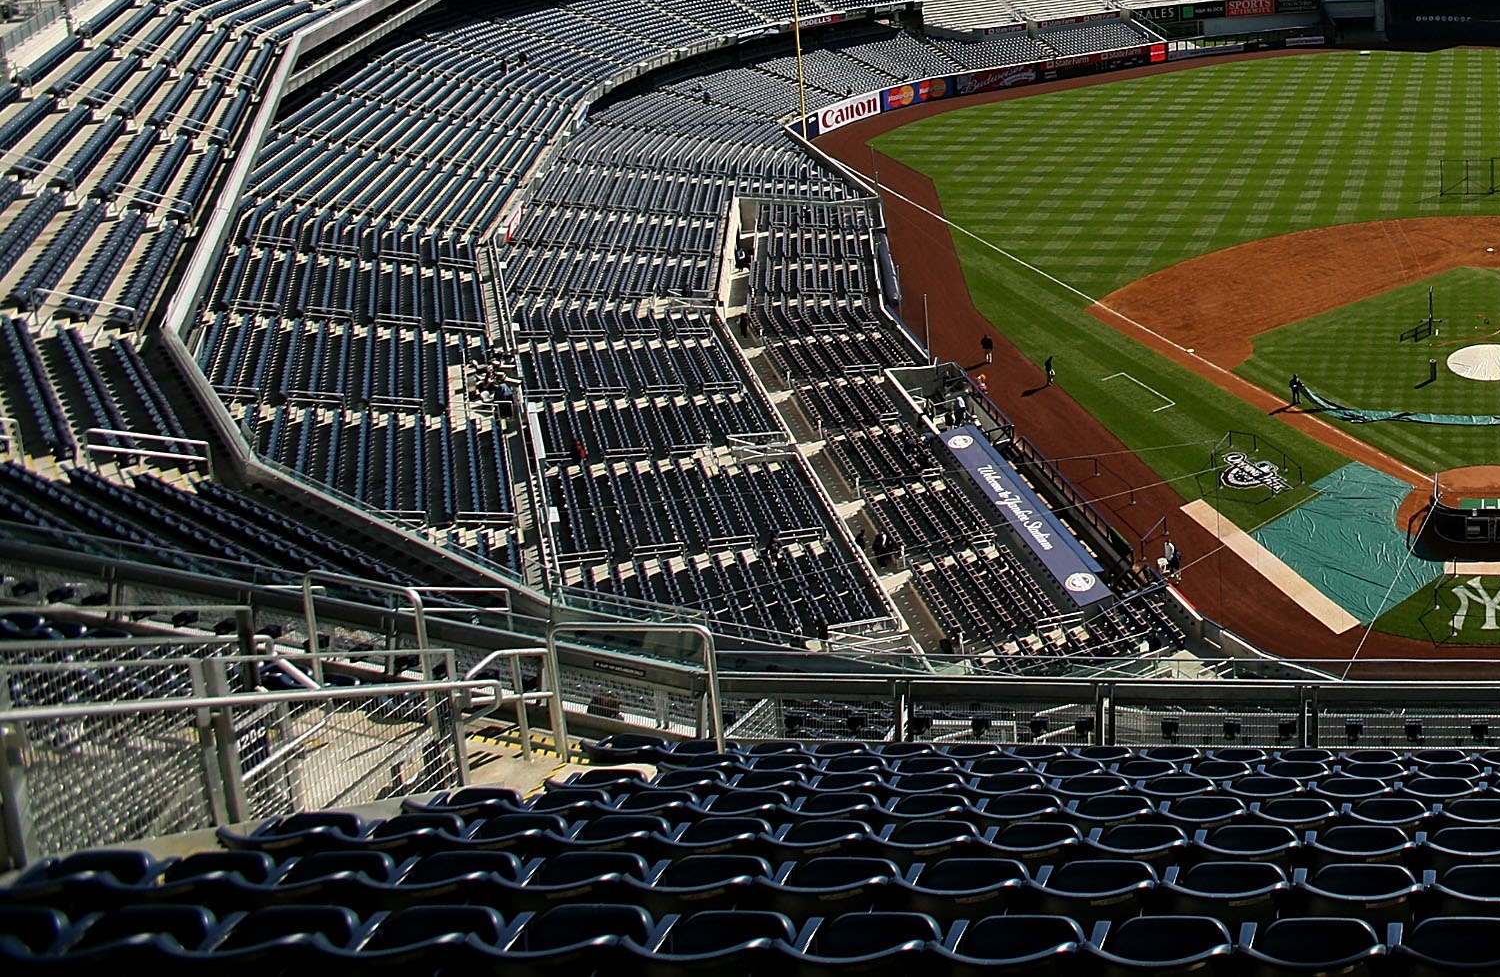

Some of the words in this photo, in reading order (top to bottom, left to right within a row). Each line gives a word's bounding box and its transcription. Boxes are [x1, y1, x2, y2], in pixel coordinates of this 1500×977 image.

[1138, 7, 1175, 20] ZALES
[1229, 7, 1272, 16] AUTHORITY
[821, 97, 878, 129] Canon
[995, 494, 1033, 522] Yankee
[1023, 520, 1054, 550] Stadium
